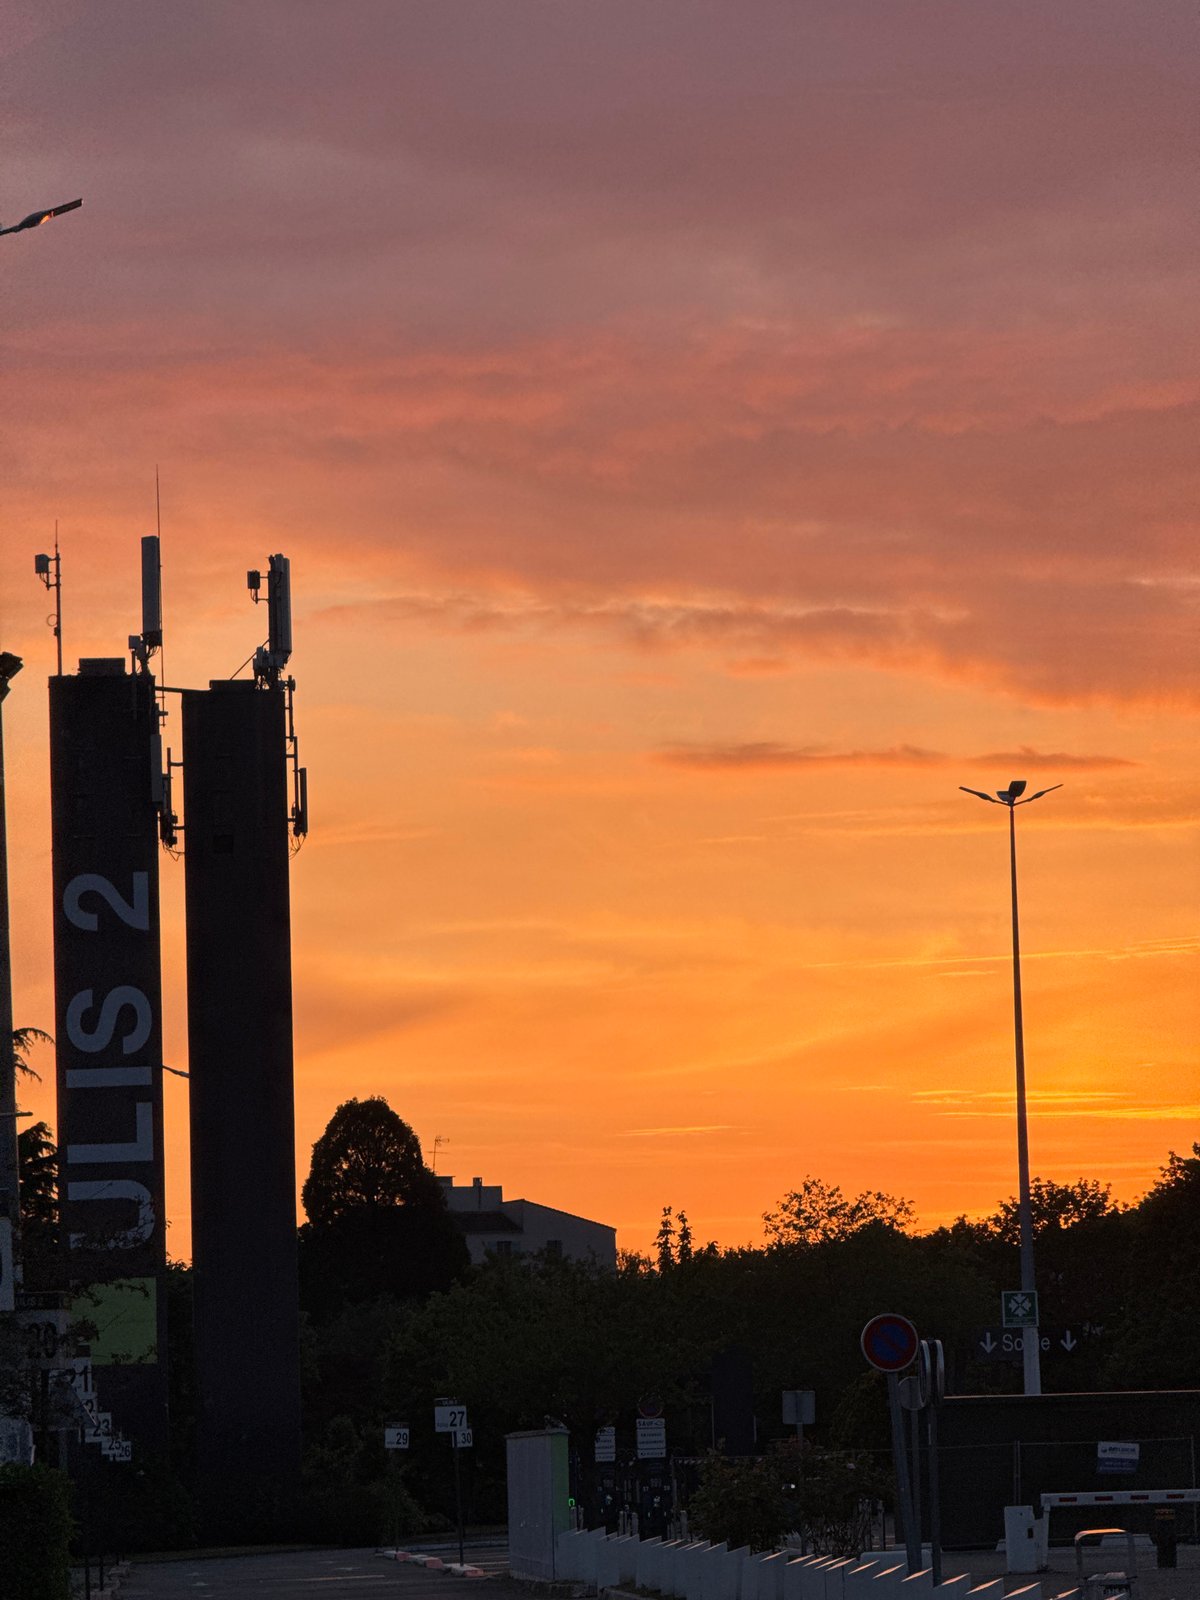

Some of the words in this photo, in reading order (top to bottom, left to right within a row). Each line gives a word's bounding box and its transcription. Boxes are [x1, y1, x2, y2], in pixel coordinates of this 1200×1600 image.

[63, 872, 149, 931] 2
[66, 985, 155, 1249] ULIS
[1002, 1333, 1050, 1351] Soe
[449, 1411, 465, 1427] 27
[396, 1432, 408, 1445] 29
[461, 1432, 472, 1444] 30
